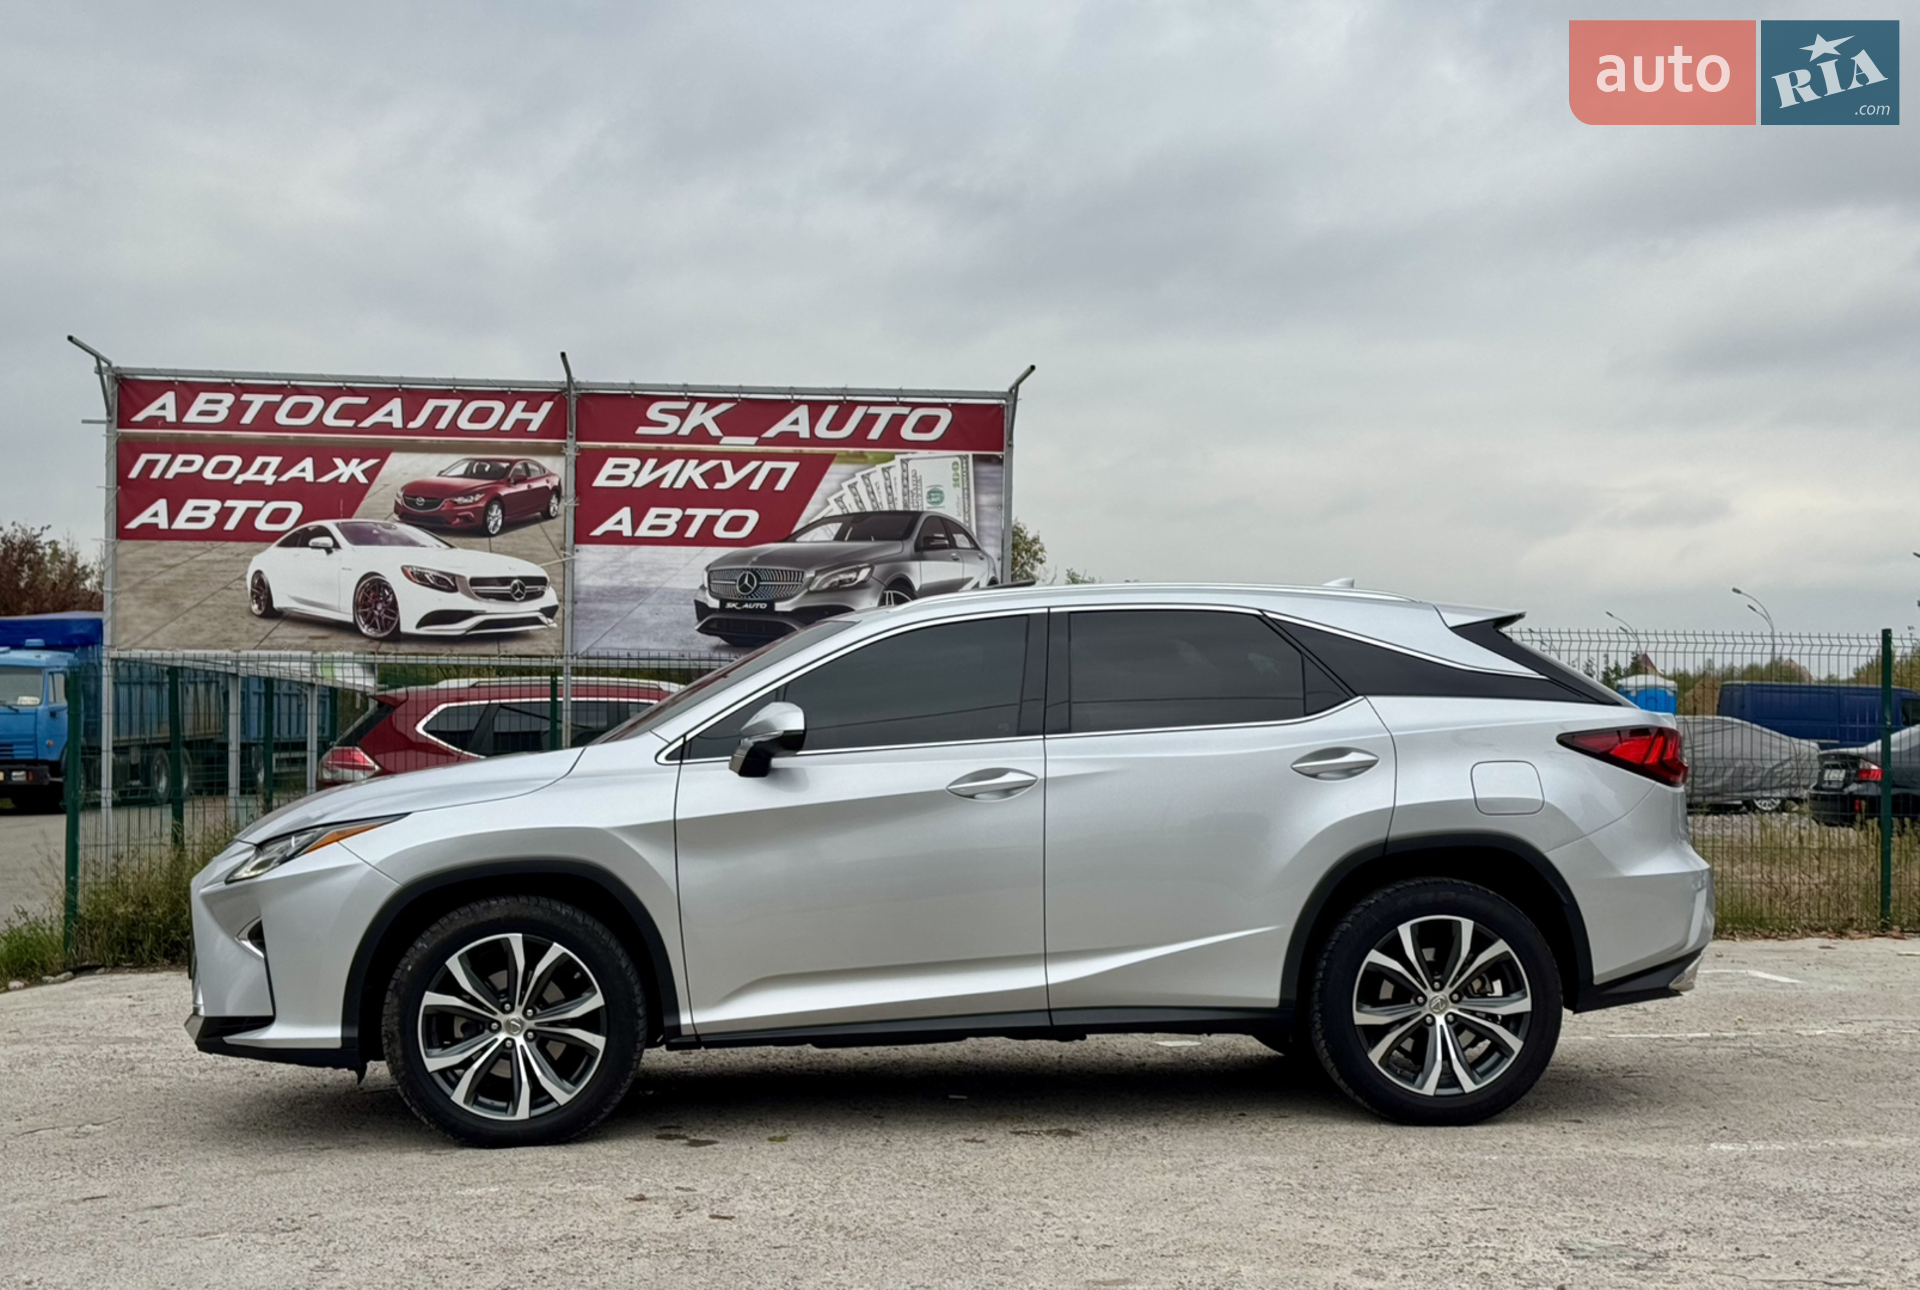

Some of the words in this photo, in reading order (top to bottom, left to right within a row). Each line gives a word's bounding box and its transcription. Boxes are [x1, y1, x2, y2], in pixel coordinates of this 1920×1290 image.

[131, 391, 555, 431] АВТОСАЛОН
[635, 401, 953, 446] SK_AUTO
[128, 453, 380, 485] ПРОДАЖ
[592, 457, 800, 491] ВИКУП
[125, 498, 303, 532] АВТО
[589, 506, 759, 539] АВТО
[725, 602, 768, 610] SK_AUTO
